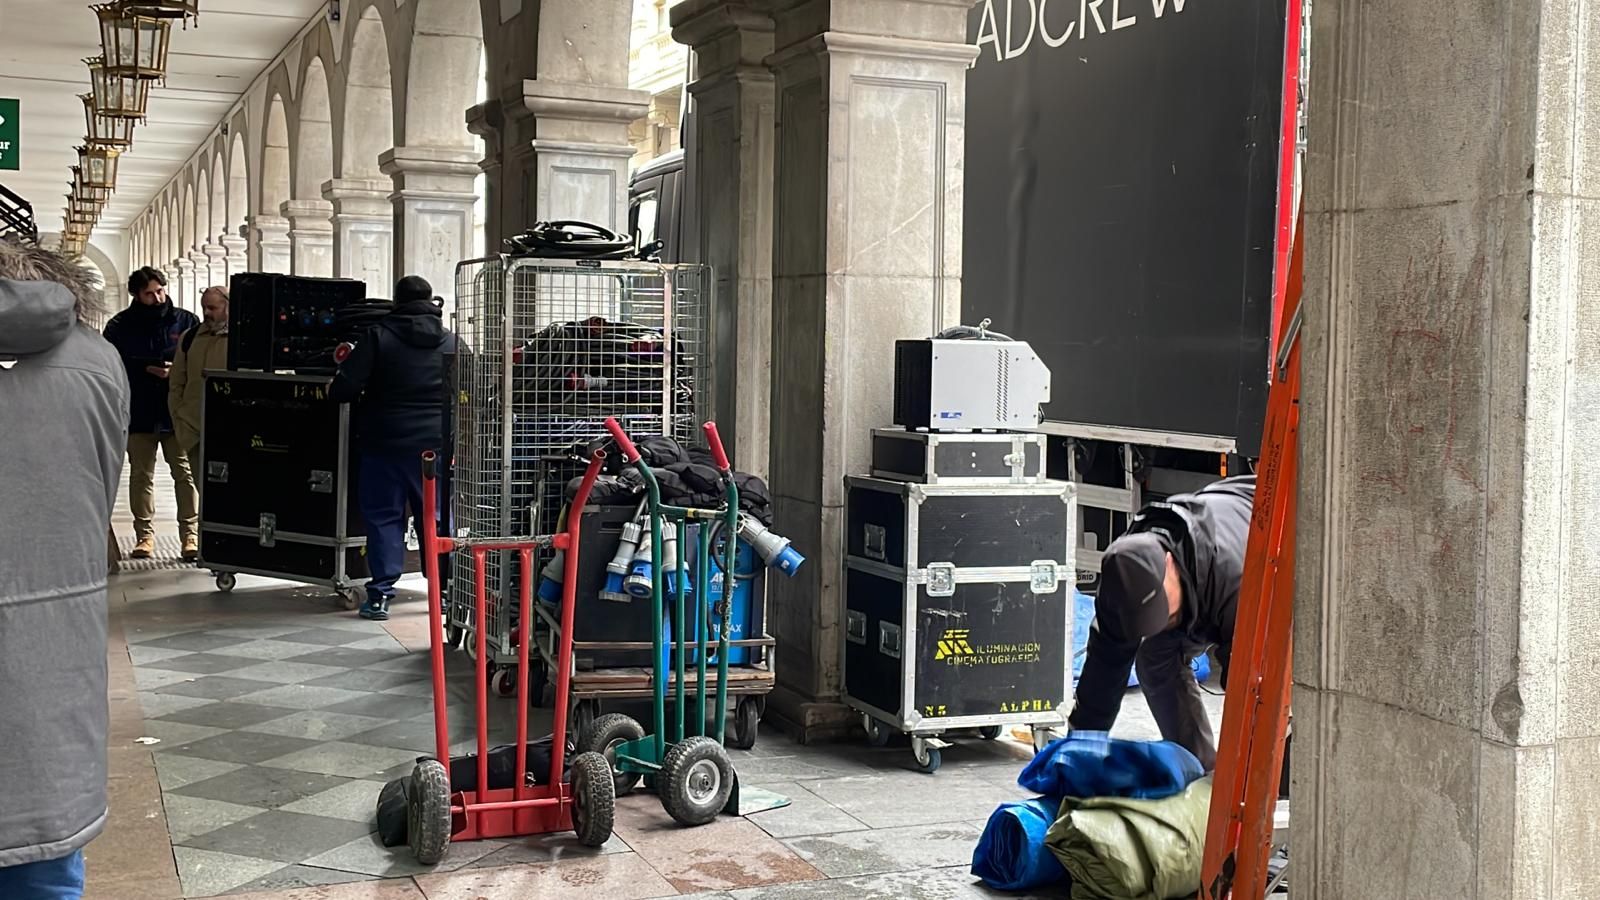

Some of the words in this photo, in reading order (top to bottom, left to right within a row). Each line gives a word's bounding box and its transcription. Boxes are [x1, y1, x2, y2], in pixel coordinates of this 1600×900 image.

[970, 0, 1186, 69] ADCR
[976, 643, 1041, 654] ILUMINACION
[1000, 699, 1052, 713] ALPHA
